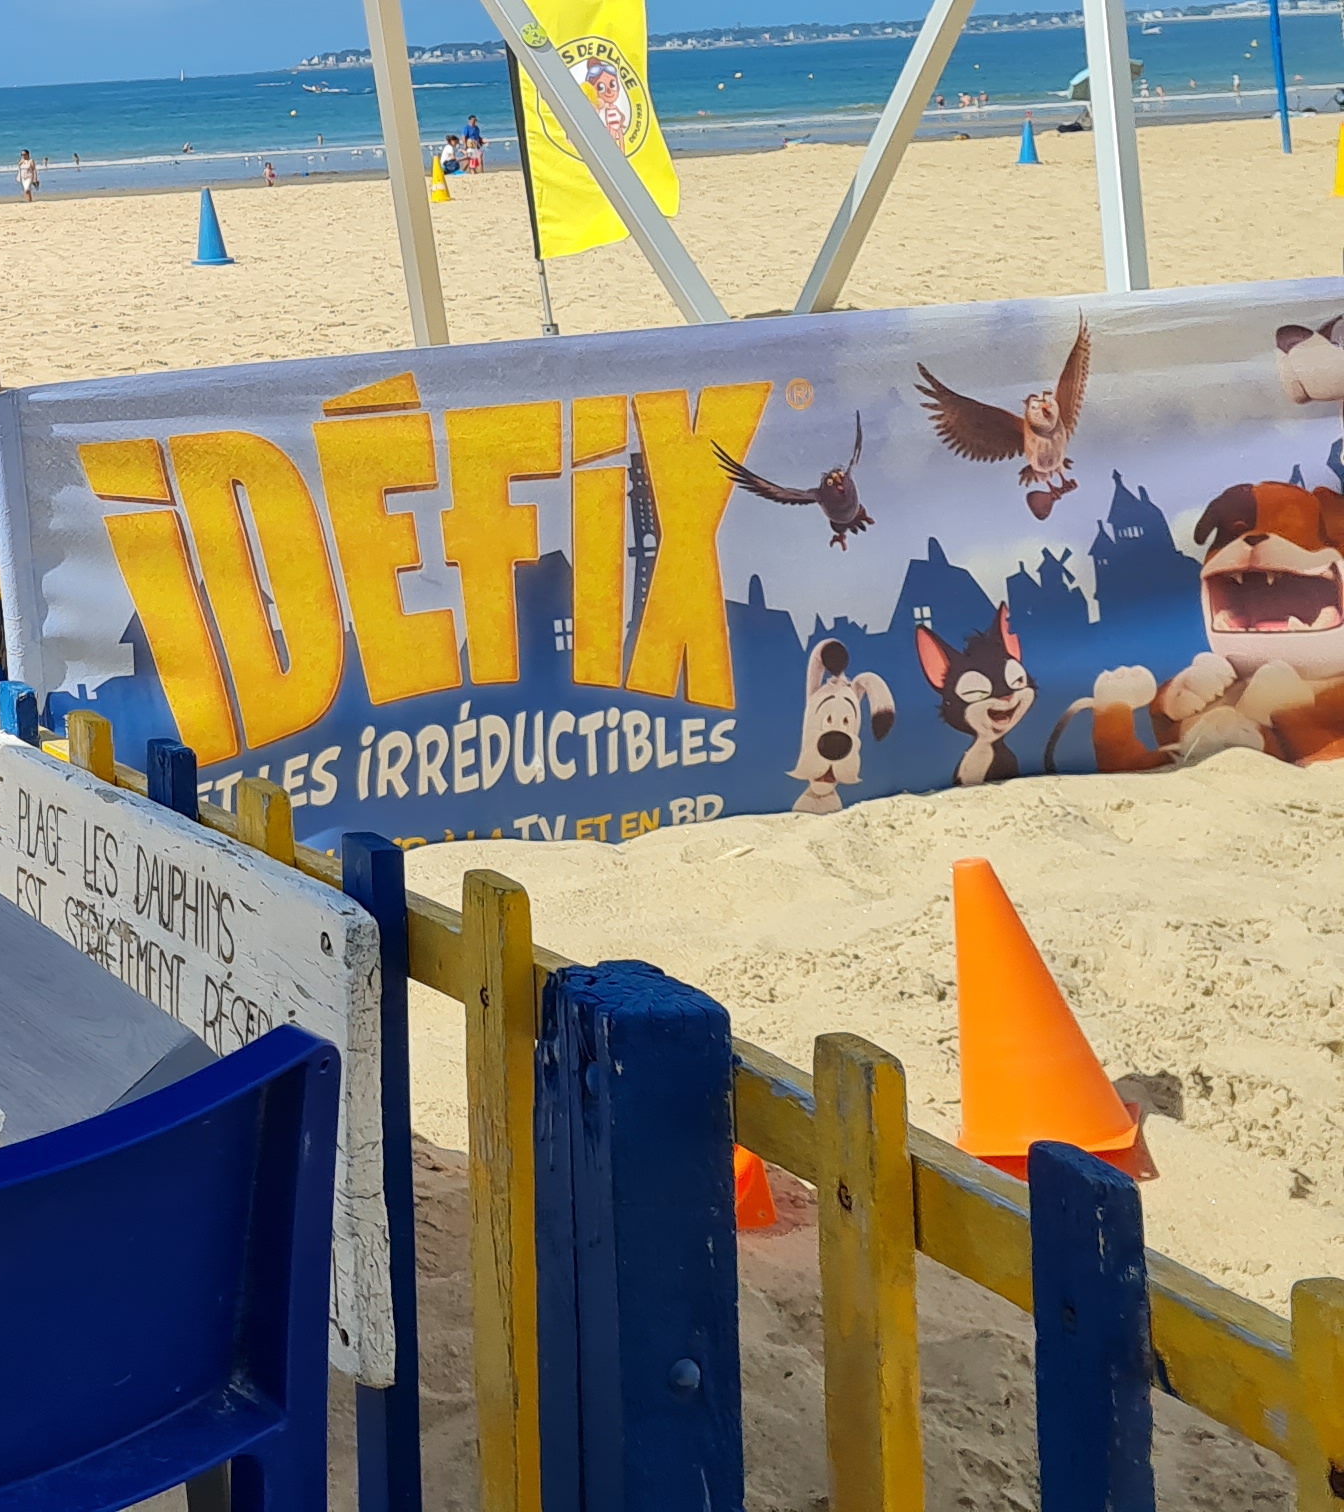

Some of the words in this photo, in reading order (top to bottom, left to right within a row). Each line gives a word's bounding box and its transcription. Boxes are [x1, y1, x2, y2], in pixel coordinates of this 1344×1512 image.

[578, 42, 594, 57] DE
[596, 43, 638, 90] PLAGE
[259, 746, 342, 808] ES
[17, 787, 67, 876] PLAGE
[83, 819, 119, 896] LES
[513, 814, 567, 841] TV
[575, 813, 613, 841] ET
[620, 807, 662, 840] EN
[669, 794, 725, 825] BD
